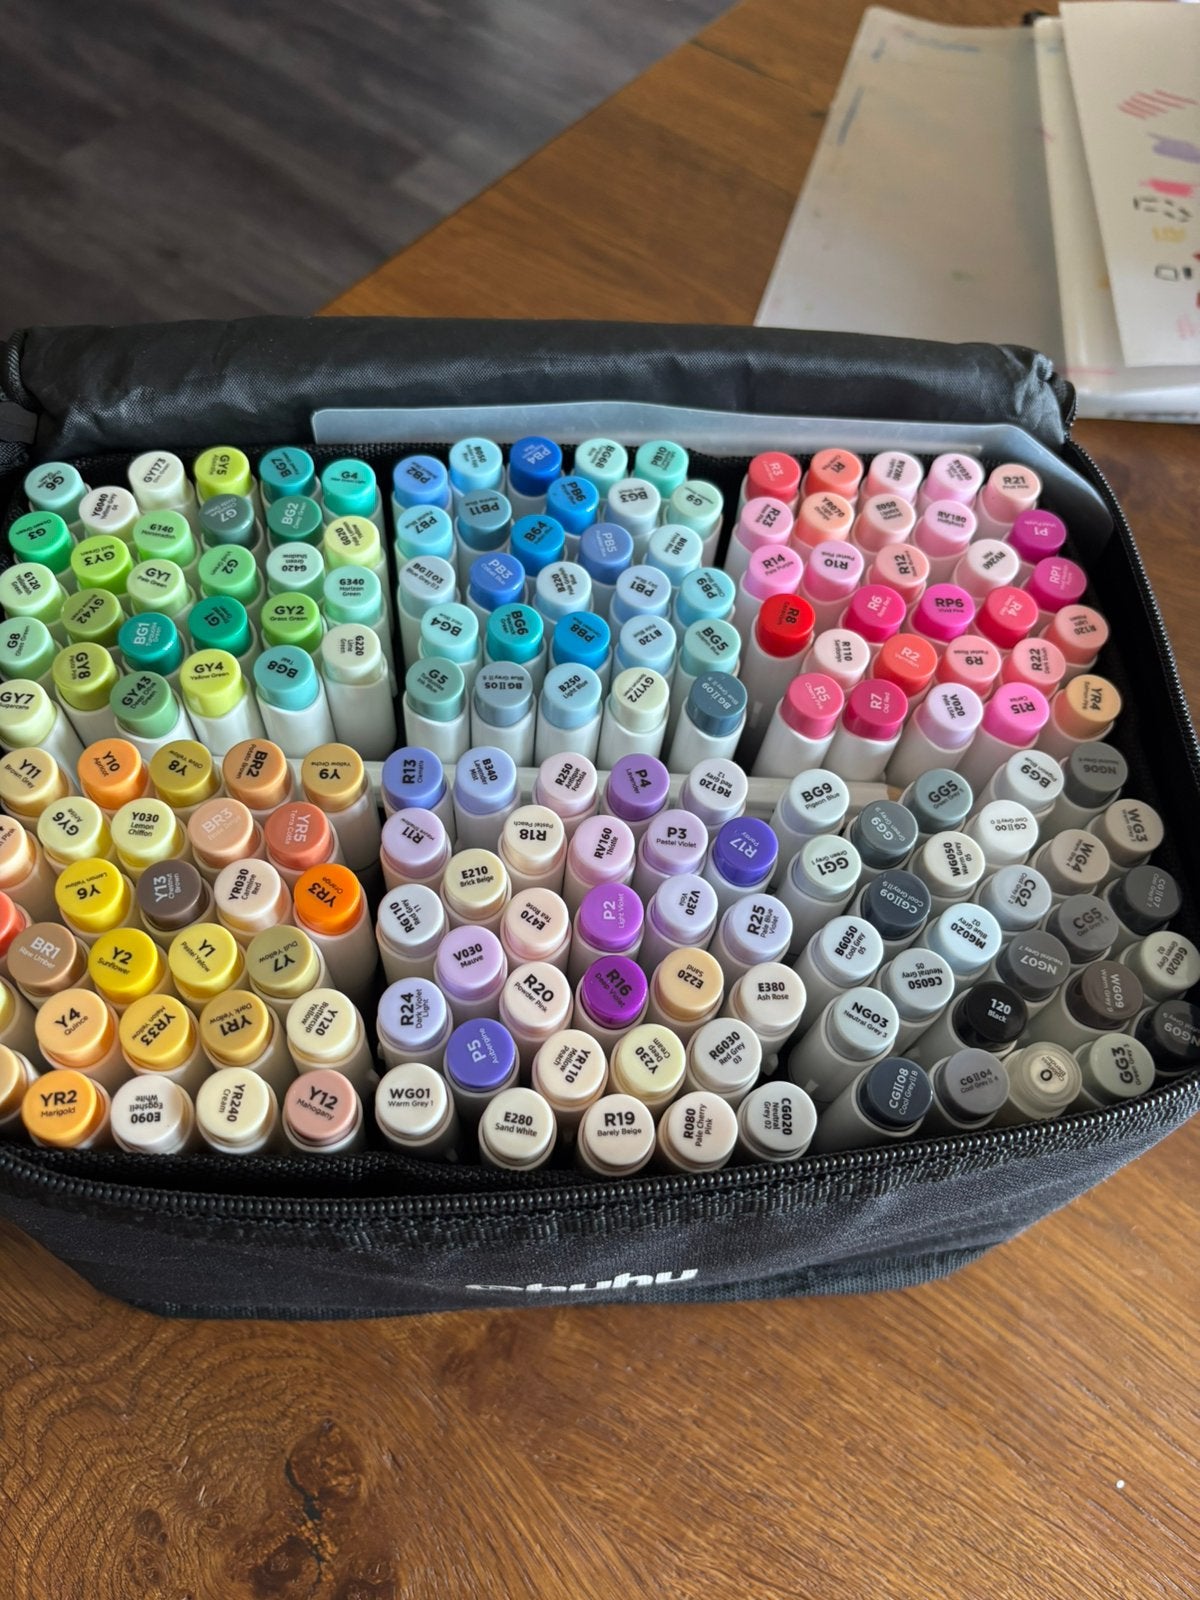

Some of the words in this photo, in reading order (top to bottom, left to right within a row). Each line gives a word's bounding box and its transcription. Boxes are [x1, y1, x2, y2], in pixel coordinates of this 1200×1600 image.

[143, 457, 166, 483] GY173
[217, 454, 230, 476] GY5
[271, 457, 292, 478] BG7
[406, 468, 431, 484] PB2
[1003, 476, 1026, 484] R21
[620, 490, 648, 502] BG3
[281, 502, 299, 525] BG2
[762, 507, 781, 528] R23
[823, 497, 845, 518] YR070
[28, 528, 46, 540] G3
[415, 516, 437, 534] PB7
[84, 551, 115, 566] GY3
[221, 559, 238, 574] G2
[488, 559, 513, 579] PB3
[762, 554, 786, 570] R14
[824, 558, 848, 570] R10
[24, 572, 41, 590] G120
[146, 568, 171, 581] GY1
[339, 578, 365, 586] G340
[629, 581, 655, 597] PB1
[696, 578, 717, 599] PB9
[76, 598, 105, 623] GY42
[274, 605, 305, 615] GY2
[868, 596, 882, 611] R6
[935, 598, 964, 608] RP6
[511, 610, 529, 636] BG6
[786, 607, 800, 624] R8
[133, 622, 150, 645] BG1
[431, 617, 462, 637] BG4
[570, 624, 595, 643] PB8
[639, 629, 662, 646] B120
[355, 635, 364, 656] G220
[702, 627, 728, 651] BG5
[842, 641, 853, 661] R110
[1030, 648, 1043, 671] R22
[76, 652, 91, 679] GY8
[194, 661, 224, 674] GY4
[267, 660, 299, 679] BG8
[428, 669, 448, 684] G5
[558, 675, 581, 693] B250
[0, 691, 35, 704] GY7
[121, 676, 151, 706] GY43
[628, 676, 655, 703] GY172
[813, 685, 831, 702] R5
[870, 693, 883, 710] R7
[949, 693, 966, 717] V020
[1011, 701, 1036, 714] R15
[19, 759, 42, 779] Y11
[102, 750, 121, 772] Y10
[168, 760, 188, 776] Y8
[246, 750, 269, 778] BR2
[402, 759, 416, 784] R13
[482, 758, 498, 781] B340
[319, 768, 341, 780] Y9
[555, 762, 574, 787] R250
[635, 769, 652, 788] P4
[1020, 764, 1051, 789] BG9
[699, 777, 732, 798] RG120
[801, 782, 833, 803] BG9
[928, 780, 959, 803] GG5
[805, 797, 826, 810] Pigeon
[825, 791, 840, 803] Blue
[52, 812, 79, 836] GY6
[131, 822, 154, 830] Lemon
[132, 812, 159, 823] Y030
[202, 809, 233, 832] BR3
[1127, 808, 1148, 843] WG3
[128, 829, 152, 837] Chiffon
[294, 814, 311, 843] YR5
[402, 826, 424, 845] R11
[519, 829, 547, 841] R18
[667, 827, 687, 839] P3
[871, 817, 894, 841] GG9
[594, 827, 612, 859] RV160
[606, 836, 619, 856] Thistle
[656, 838, 677, 846] Pastel
[729, 837, 758, 859] R17
[817, 857, 849, 876] GG1
[943, 842, 962, 877] WG050
[460, 878, 476, 888] Brick
[476, 875, 494, 885] Beige
[461, 865, 489, 879] E210
[77, 884, 101, 900] Y6
[153, 876, 168, 902] Y13
[228, 868, 249, 901] YR030
[241, 875, 256, 900] Carmine
[308, 882, 336, 908] YR3
[1015, 880, 1036, 907] CG2
[603, 901, 616, 920] P2
[685, 890, 701, 916] V230
[390, 901, 415, 933] RG110
[521, 910, 546, 931] E470
[747, 905, 765, 935] R25
[1073, 907, 1103, 929] CG5
[834, 925, 858, 957] BG050
[950, 922, 986, 950] MG020
[30, 936, 60, 959] BR1
[112, 946, 132, 965] Y2
[199, 939, 216, 958] Y1
[453, 943, 483, 962] V030
[97, 957, 130, 975] Sunflower
[272, 954, 296, 973] Y7
[460, 954, 484, 969] Mauve
[686, 964, 704, 977] Sand
[1020, 955, 1057, 975] NG07
[523, 973, 554, 1003] R20
[606, 969, 633, 997] R16
[677, 969, 704, 990] E220
[758, 982, 786, 993] E380
[908, 976, 943, 990] CG050
[514, 982, 536, 1002] Powder
[534, 998, 548, 1013] Pink
[757, 993, 770, 1001] Ash
[1111, 974, 1125, 1008] WG09
[301, 1004, 320, 1026] Yellow
[400, 992, 414, 1026] R24
[851, 1002, 889, 1028] NG03
[987, 1010, 1007, 1023] Black
[990, 998, 1012, 1015] 120
[54, 1007, 81, 1029] Y4
[64, 1015, 89, 1036] Quince
[219, 1014, 253, 1037] YR1
[305, 1002, 329, 1034] Buttercup
[315, 1009, 339, 1037] Y120
[140, 1011, 176, 1047] YR33
[467, 1039, 487, 1063] P5
[708, 1031, 741, 1060] RG030
[565, 1049, 591, 1083] YR110
[635, 1046, 659, 1074] Y230
[1111, 1047, 1133, 1084] GG3
[40, 1090, 77, 1107] YR2
[226, 1084, 246, 1122] YR240
[309, 1086, 338, 1110] Y12
[390, 1088, 431, 1099] WG01
[40, 1107, 76, 1118] Marigold
[131, 1111, 161, 1124] E090
[297, 1098, 335, 1121] Mahogany
[503, 1111, 533, 1126] E280
[604, 1111, 635, 1127] R19
[781, 1097, 793, 1136] CG020
[495, 1123, 516, 1133] Sand
[516, 1126, 538, 1137] White
[597, 1129, 621, 1137] Barely
[683, 1108, 696, 1139] R080
[465, 1269, 698, 1291] huhu
